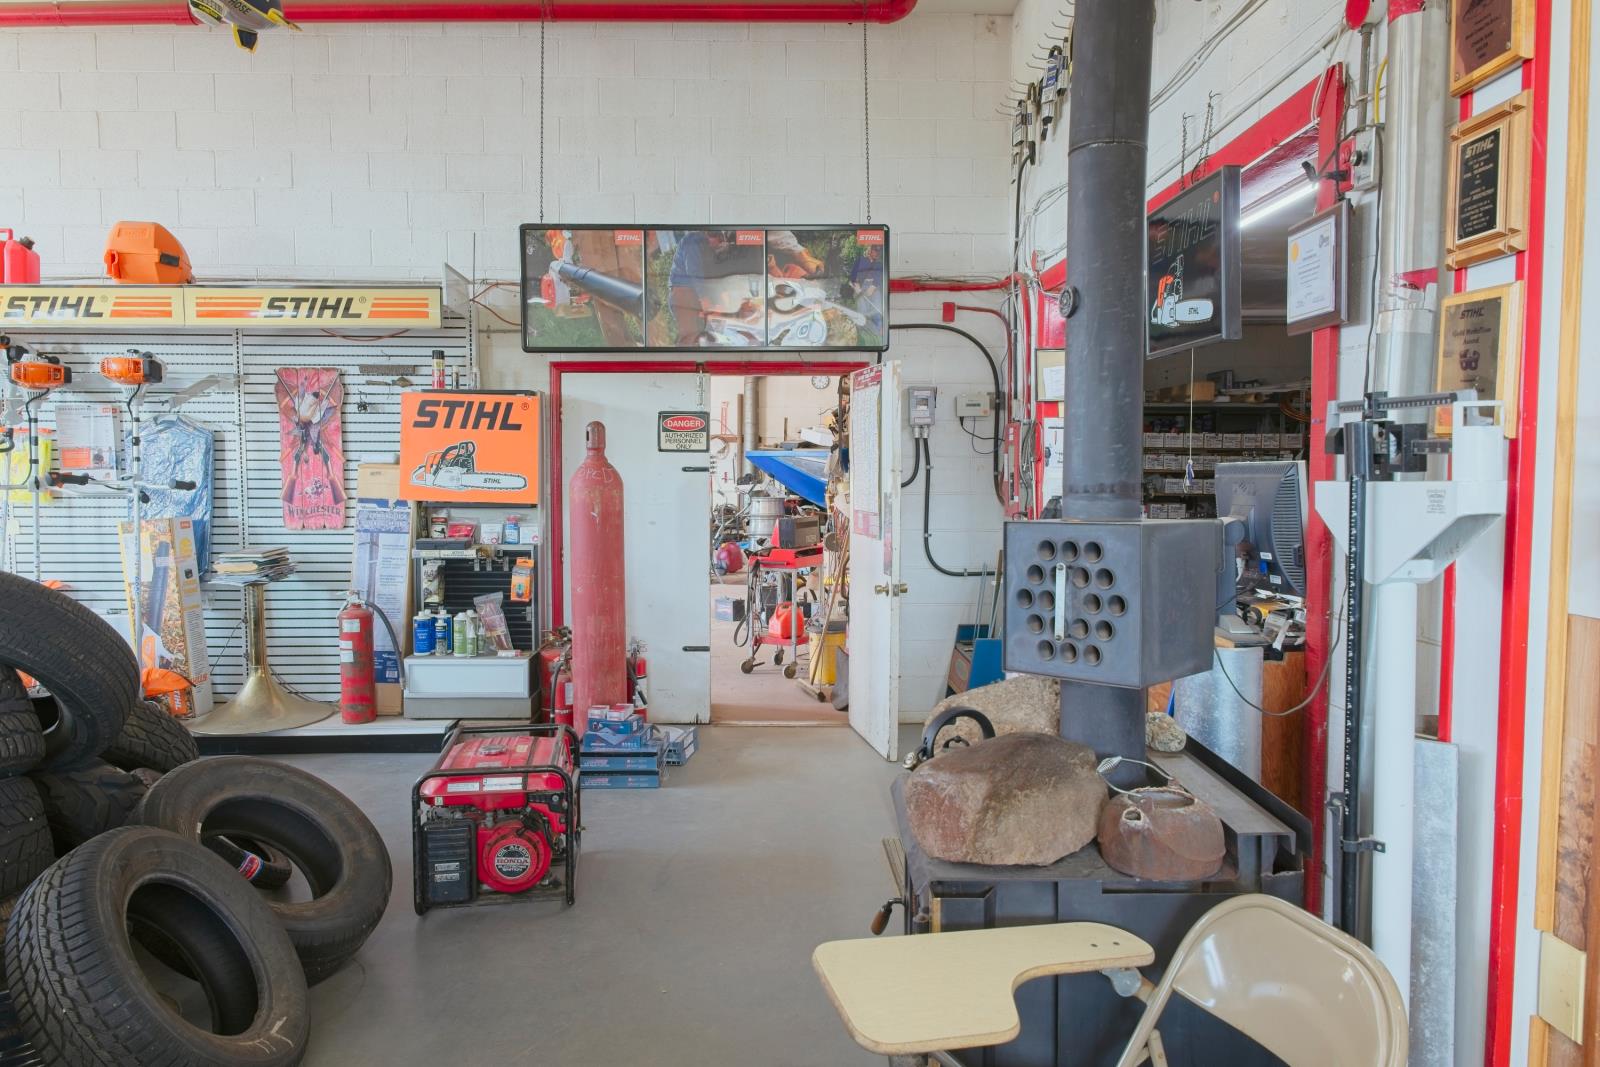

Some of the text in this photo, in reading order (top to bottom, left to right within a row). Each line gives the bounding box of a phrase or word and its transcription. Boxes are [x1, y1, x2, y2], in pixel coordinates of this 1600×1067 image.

[1465, 135, 1495, 158] STIHL
[4, 296, 104, 318] STIHL
[263, 297, 362, 319] STIHL
[1460, 306, 1485, 320] STIHL
[412, 399, 523, 431] STIHL
[667, 420, 701, 428] DANGER
